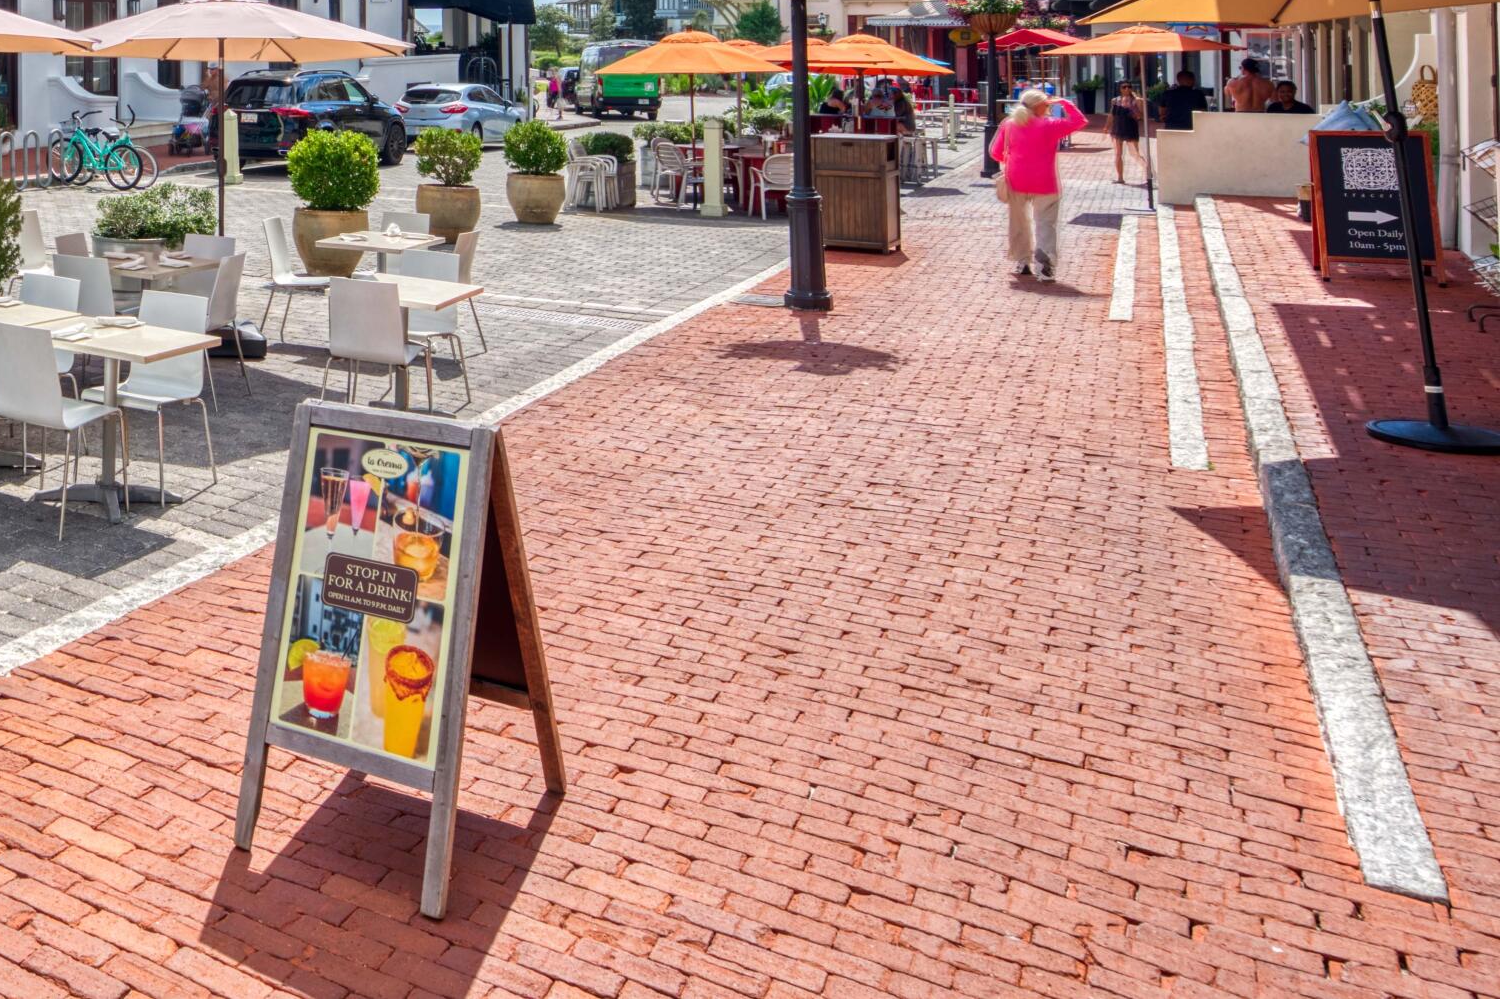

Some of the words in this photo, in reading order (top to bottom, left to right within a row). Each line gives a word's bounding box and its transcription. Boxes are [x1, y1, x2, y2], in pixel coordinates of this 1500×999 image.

[1348, 228, 1375, 239] Open
[1377, 229, 1404, 241] Daily
[1349, 241, 1375, 249] 10am
[1383, 242, 1406, 253] 5pm
[346, 564, 380, 580] STOP
[382, 571, 396, 584] IN
[328, 574, 353, 590] FOR
[355, 581, 364, 592] A
[367, 583, 412, 602] DRINK!
[328, 591, 344, 601] OPEN
[363, 598, 371, 606] TO
[387, 604, 406, 614] DAILY
